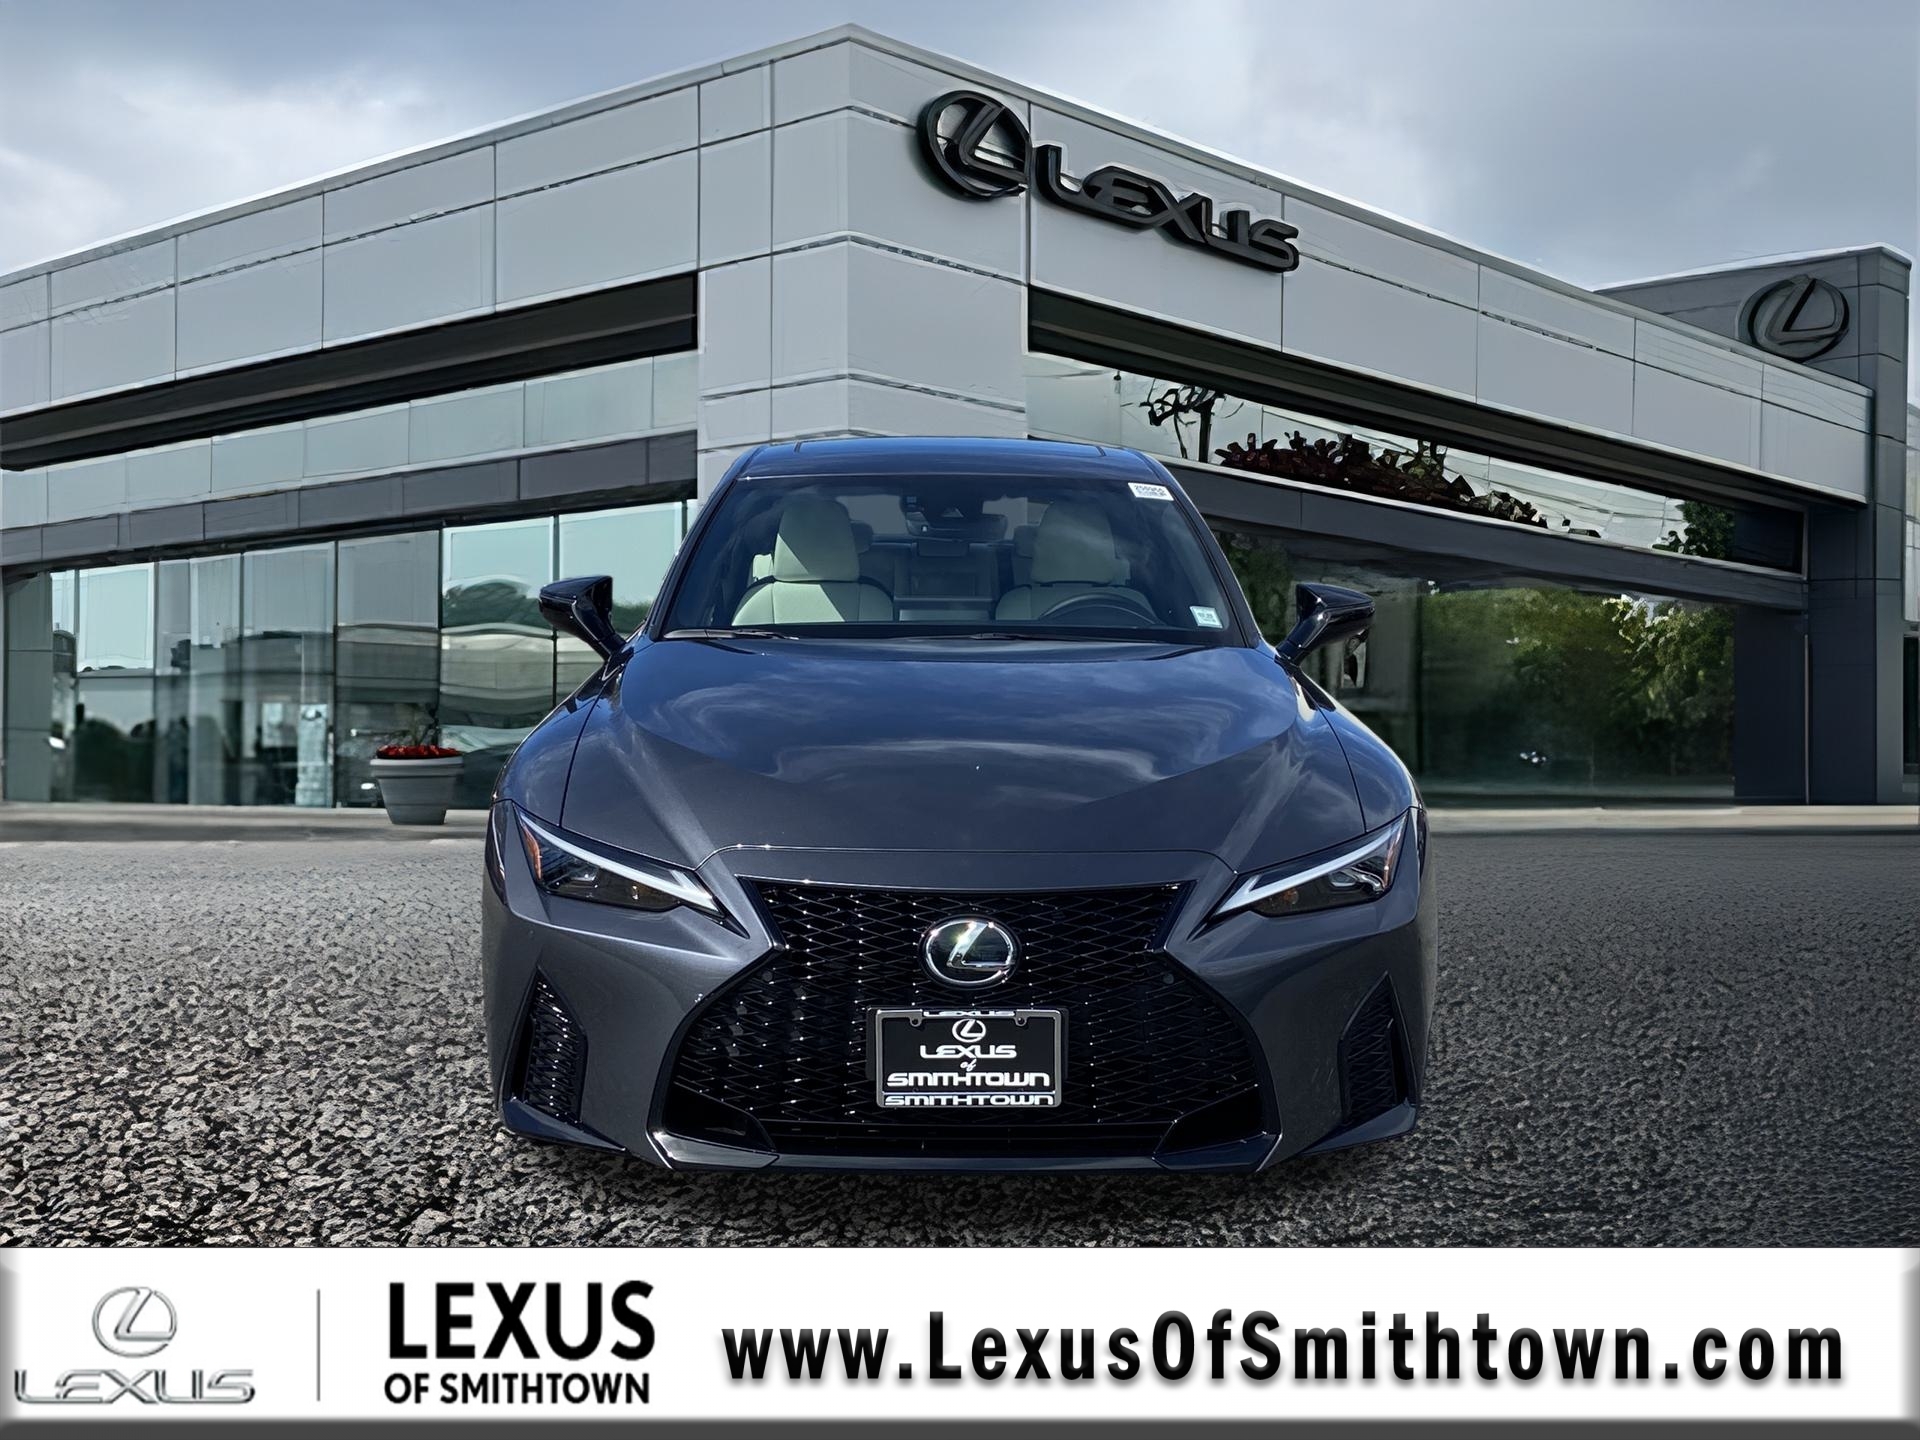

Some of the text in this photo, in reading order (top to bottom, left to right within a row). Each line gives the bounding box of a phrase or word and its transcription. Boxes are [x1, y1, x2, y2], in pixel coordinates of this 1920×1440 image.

[1034, 143, 1299, 273] LEXUS
[919, 1044, 1017, 1059] LEXUS
[959, 1058, 977, 1072] of
[887, 1072, 1050, 1087] SMITHTOWN
[884, 1095, 1054, 1106] SMITHTOWN
